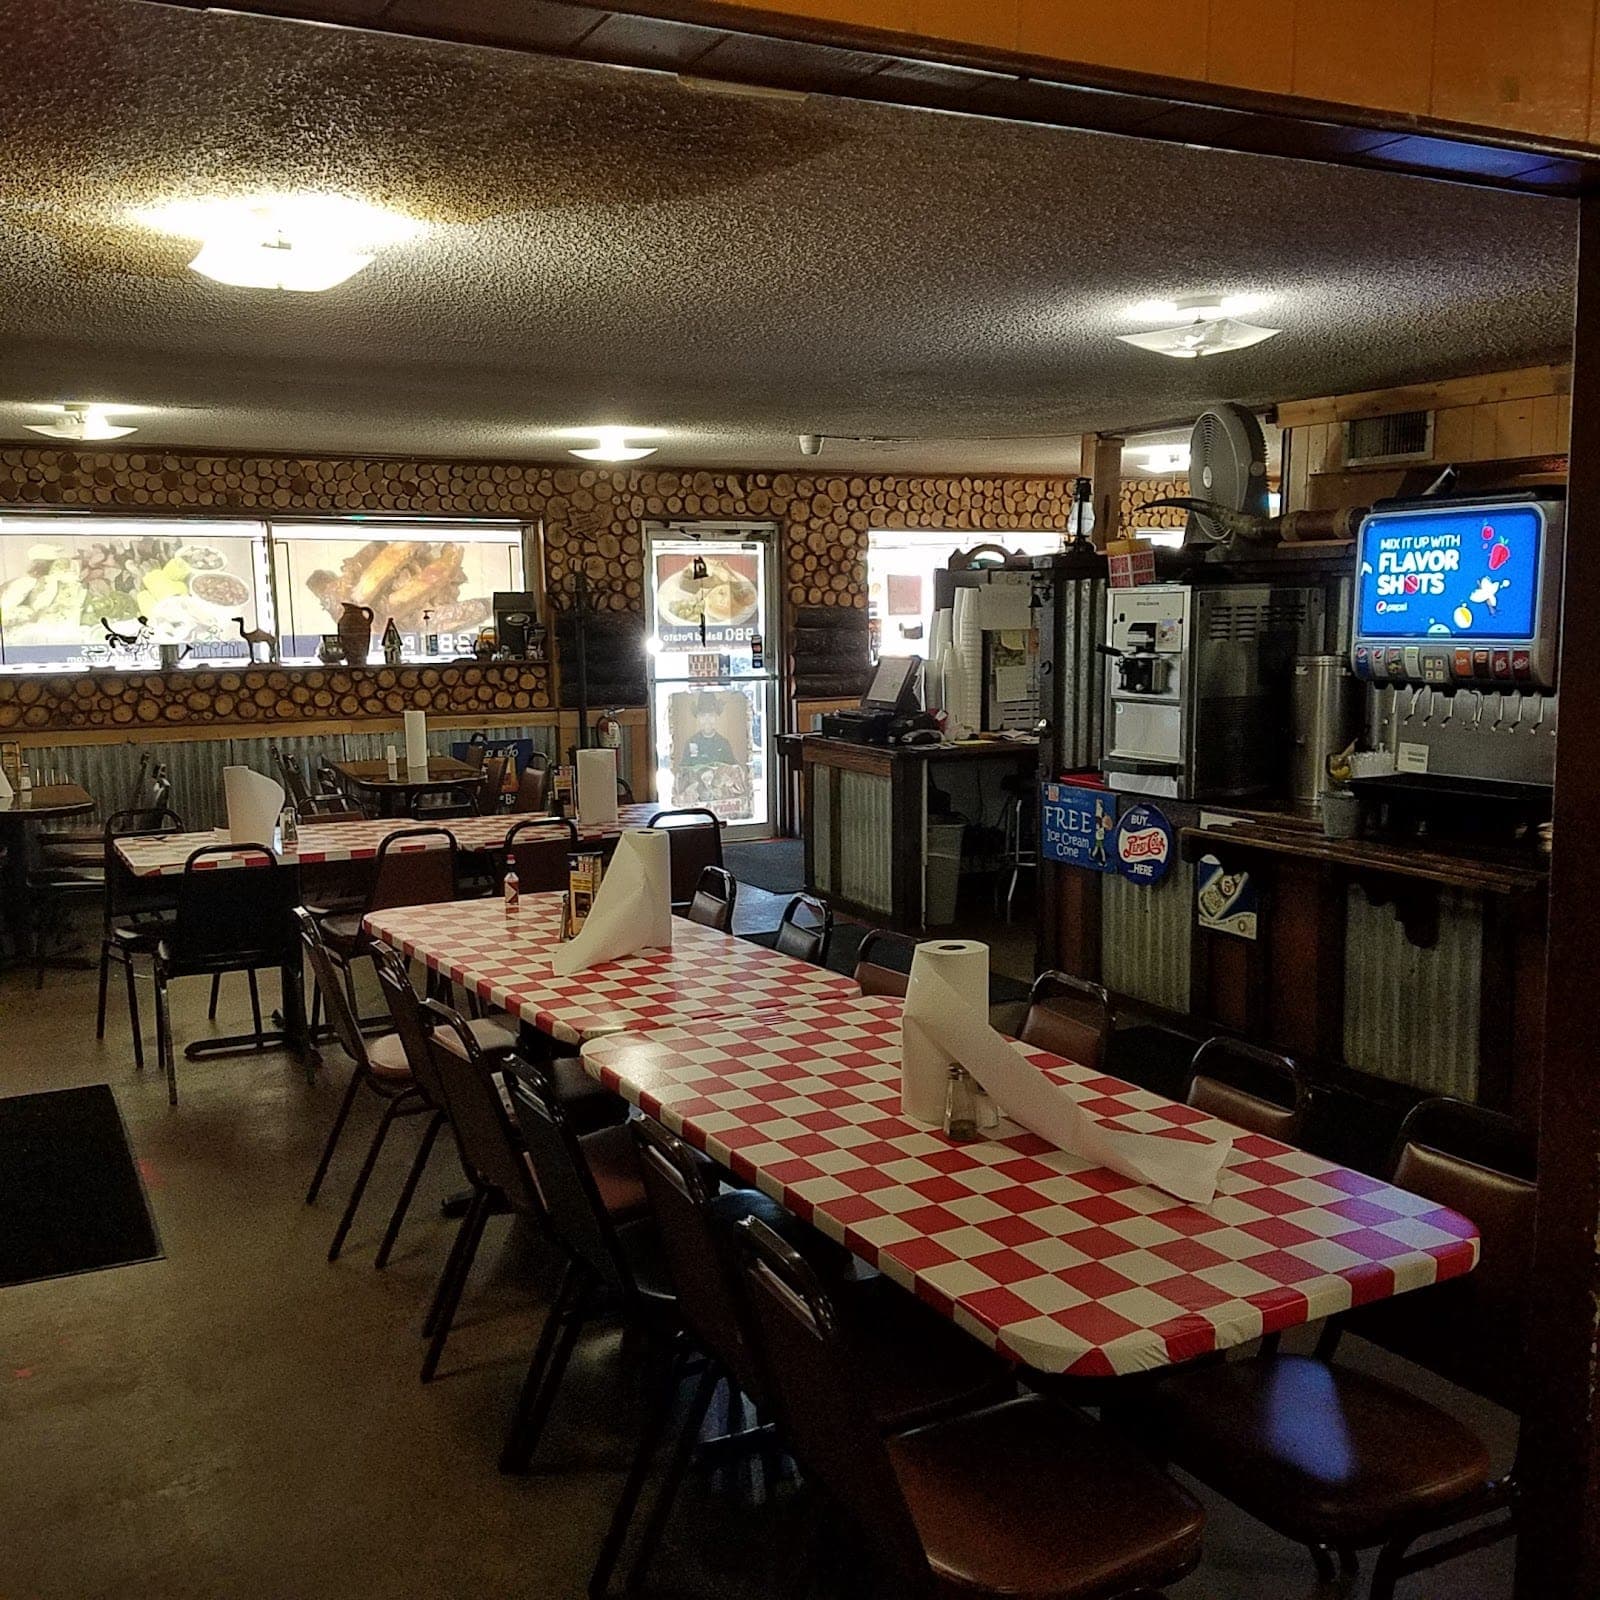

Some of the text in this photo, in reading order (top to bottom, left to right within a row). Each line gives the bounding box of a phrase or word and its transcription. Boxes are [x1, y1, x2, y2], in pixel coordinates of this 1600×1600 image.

[1380, 533, 1461, 550] MIX IT UP WITH
[1378, 549, 1460, 573] FLAVOR
[1377, 573, 1445, 595] SHOTS
[1043, 805, 1092, 834] FREE
[1047, 828, 1090, 849] Ice Cream
[1056, 843, 1080, 858] Cone
